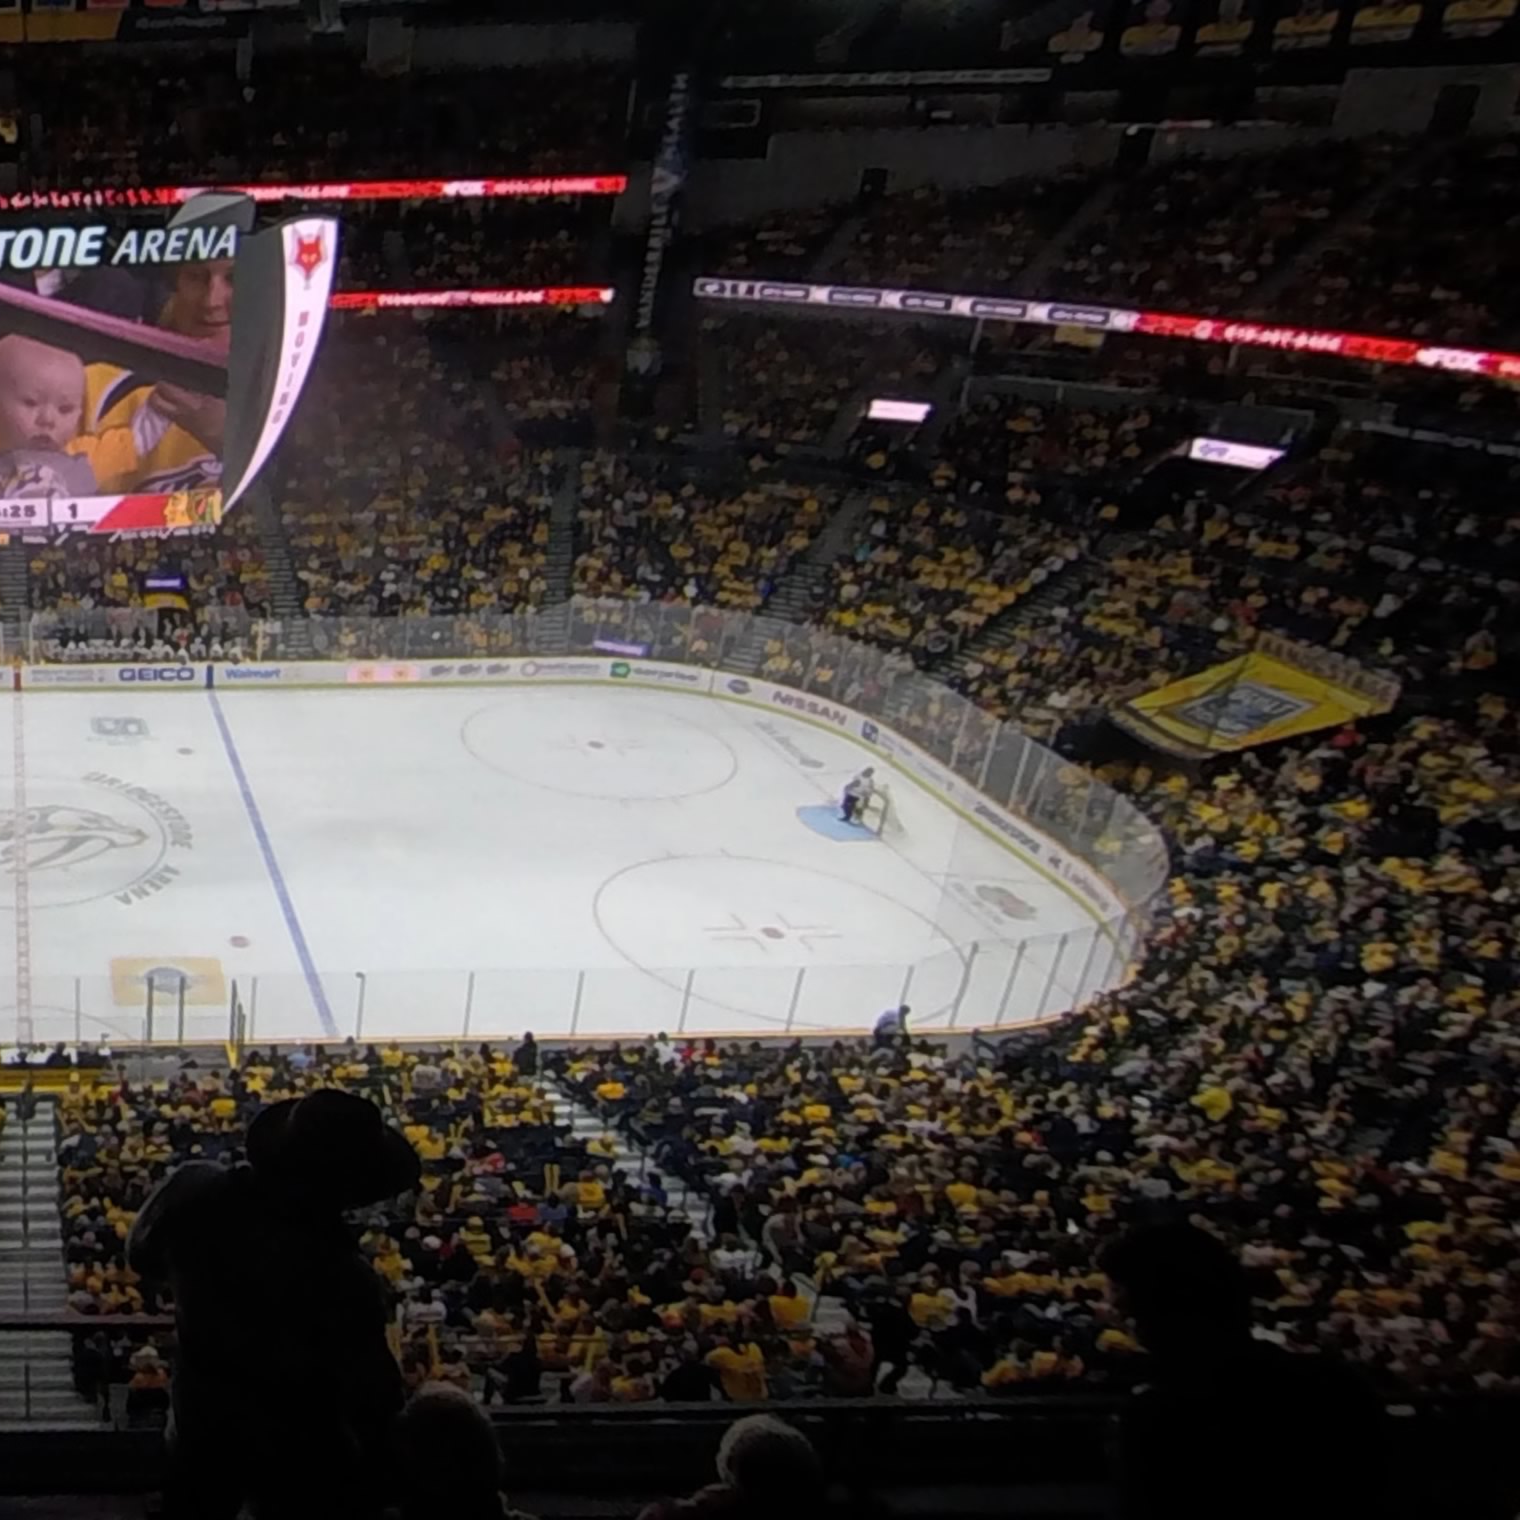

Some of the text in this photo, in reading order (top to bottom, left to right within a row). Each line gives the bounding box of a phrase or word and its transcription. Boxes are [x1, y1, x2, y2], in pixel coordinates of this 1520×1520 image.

[112, 224, 238, 264] ARENA
[68, 502, 79, 520] 1
[118, 667, 194, 681] GEICO
[226, 668, 282, 680] Walmart
[773, 690, 848, 726] NISSAN
